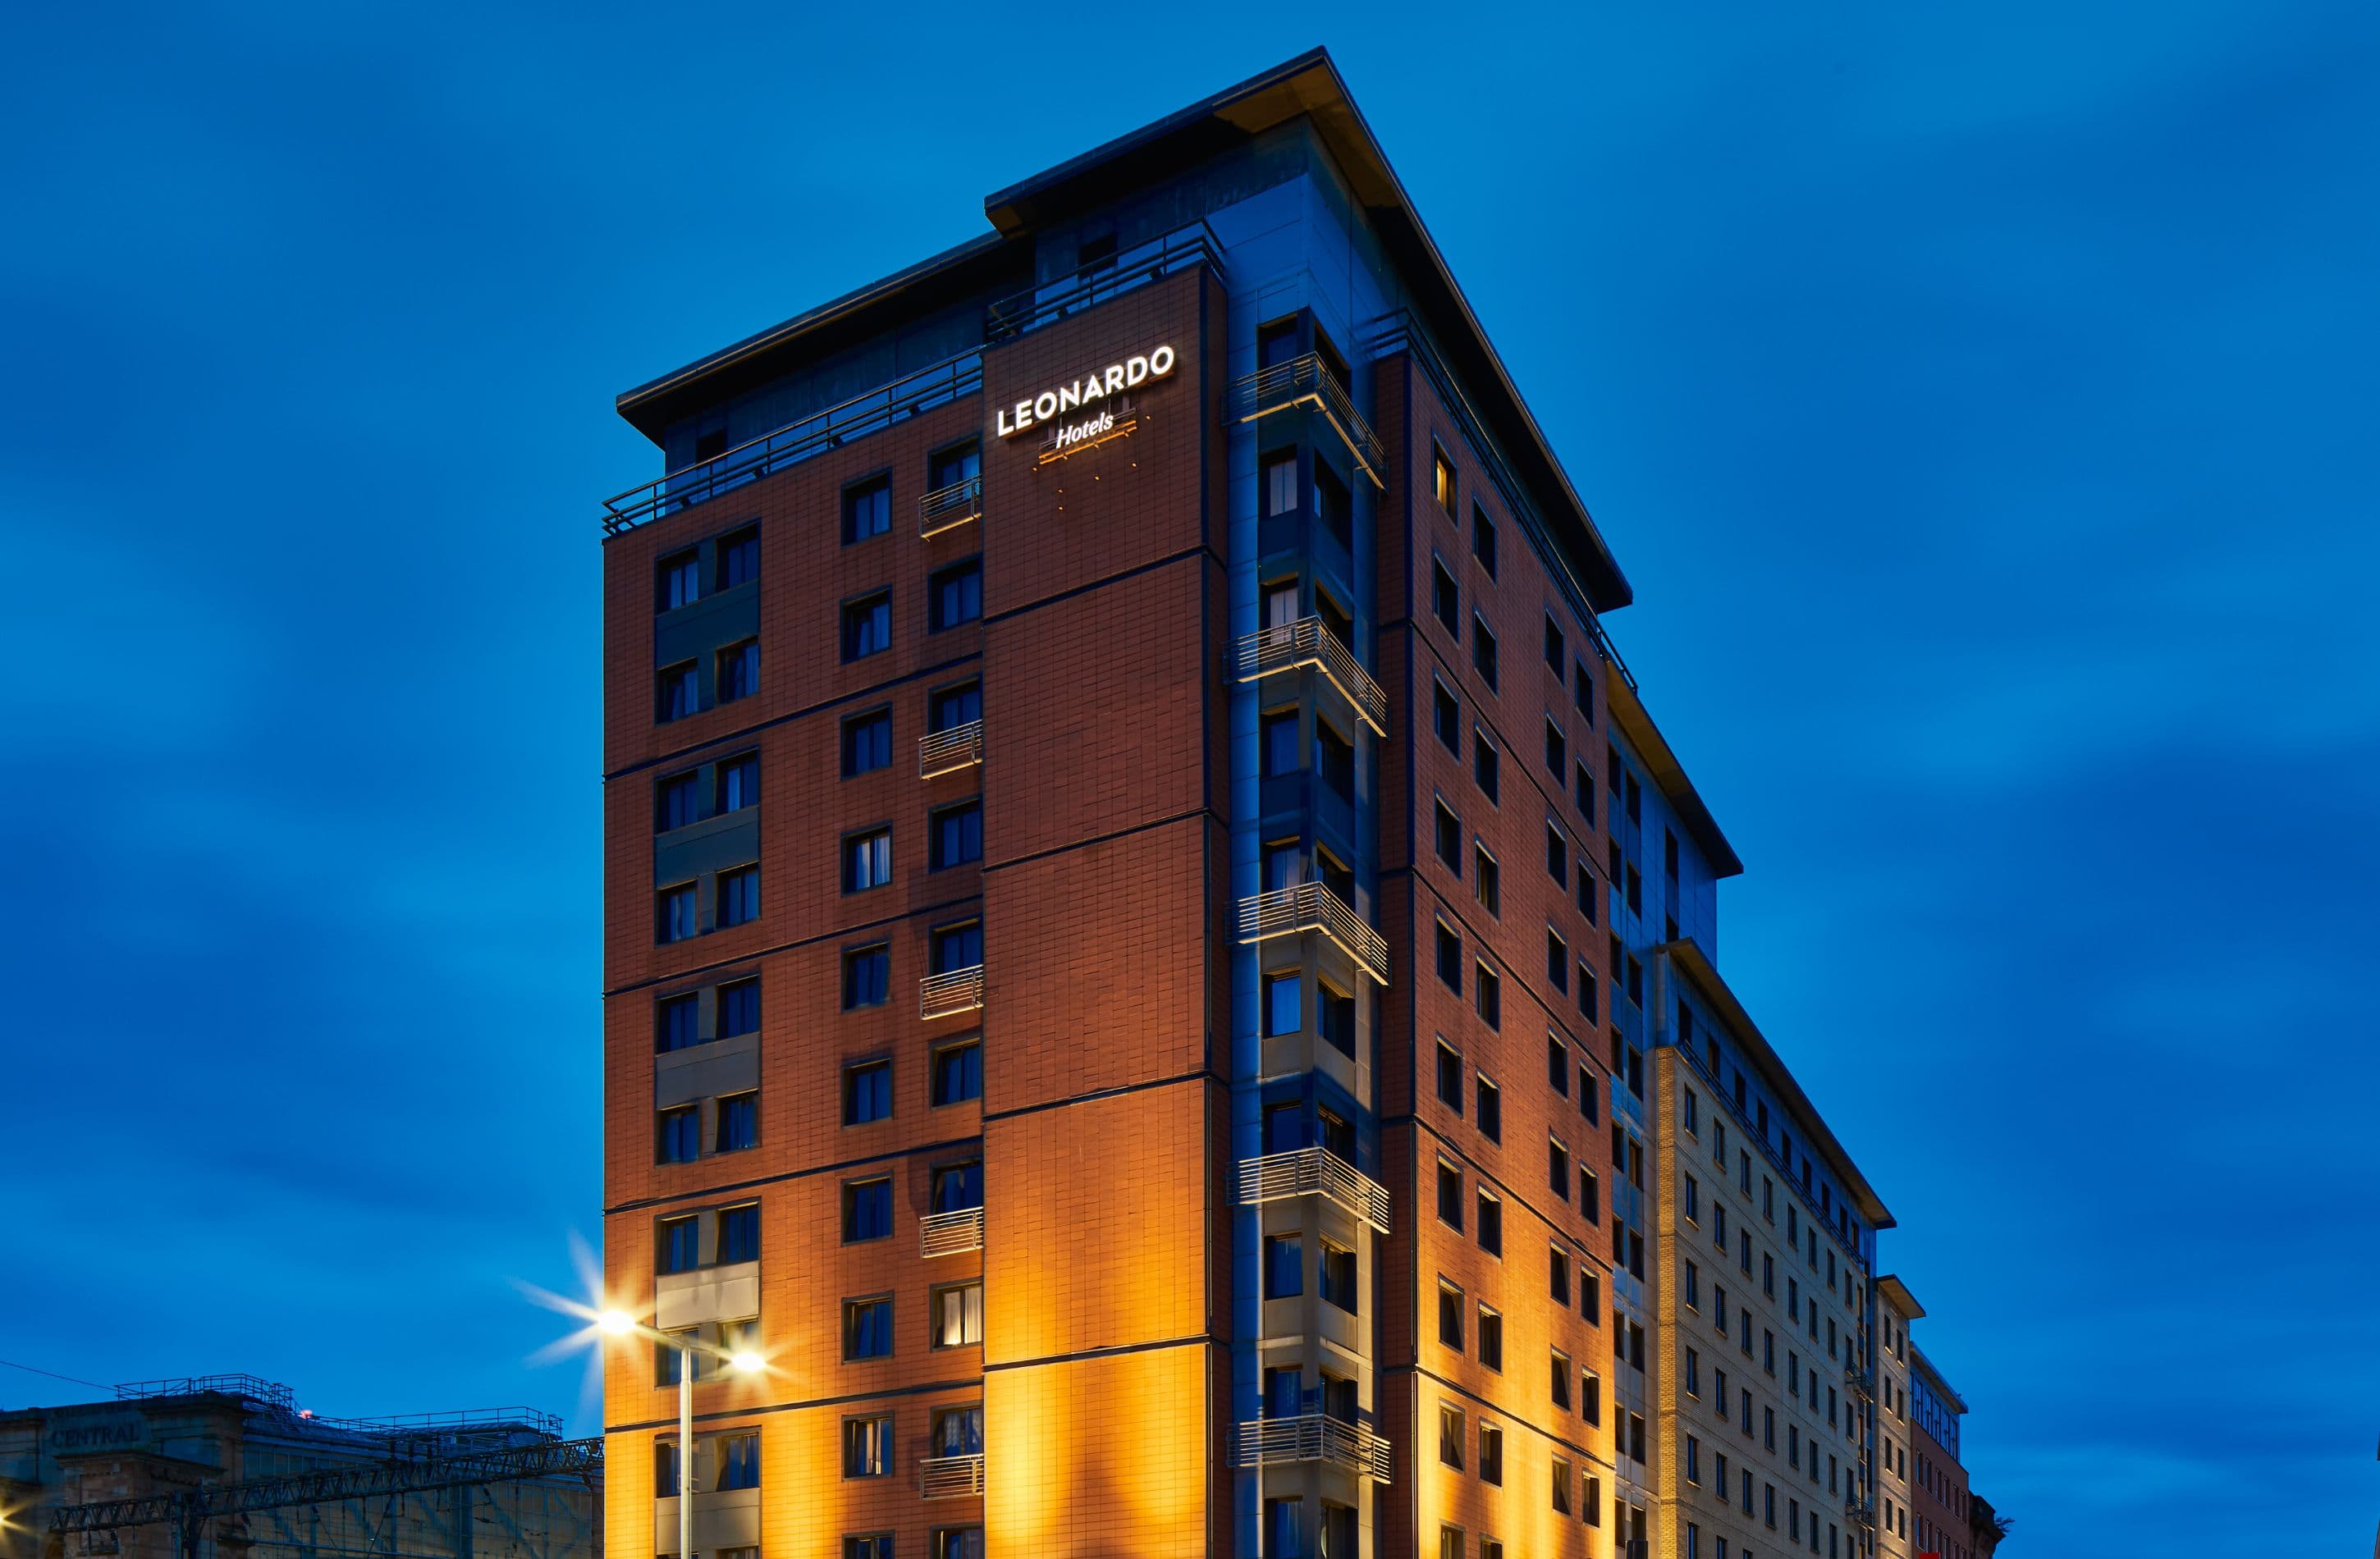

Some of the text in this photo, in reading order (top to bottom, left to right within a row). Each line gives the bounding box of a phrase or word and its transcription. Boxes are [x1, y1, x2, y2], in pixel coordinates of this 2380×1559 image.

[997, 345, 1174, 437] LEONARDO
[1055, 411, 1114, 449] Hotels
[52, 1423, 140, 1449] CENTRAL
